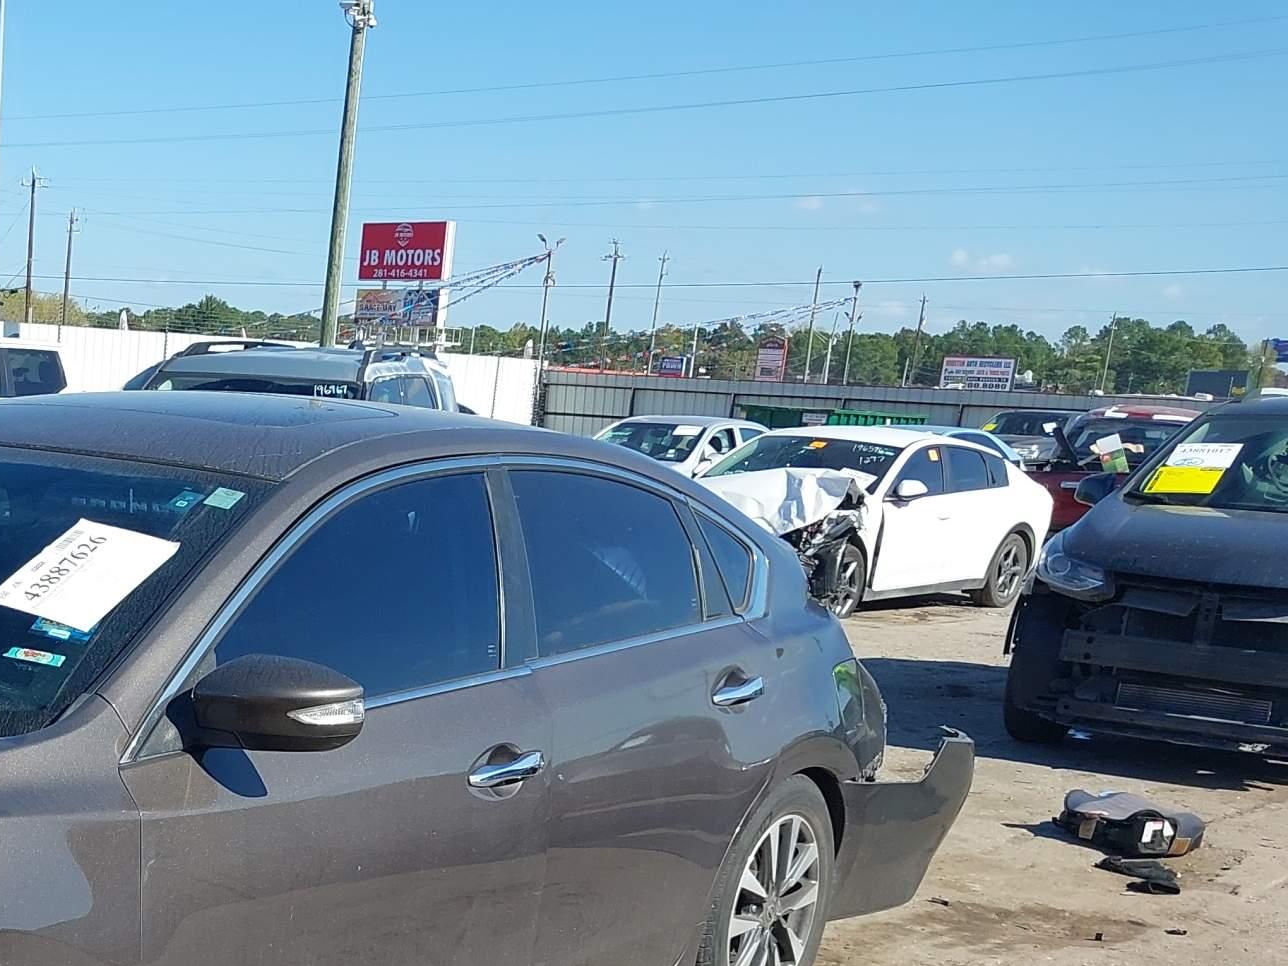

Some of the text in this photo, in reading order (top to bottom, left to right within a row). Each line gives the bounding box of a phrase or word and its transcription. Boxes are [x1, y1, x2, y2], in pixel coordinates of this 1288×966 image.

[363, 249, 441, 266] JB MOTORS
[372, 269, 428, 278] 281-416-4341
[23, 535, 108, 603] 43887626
